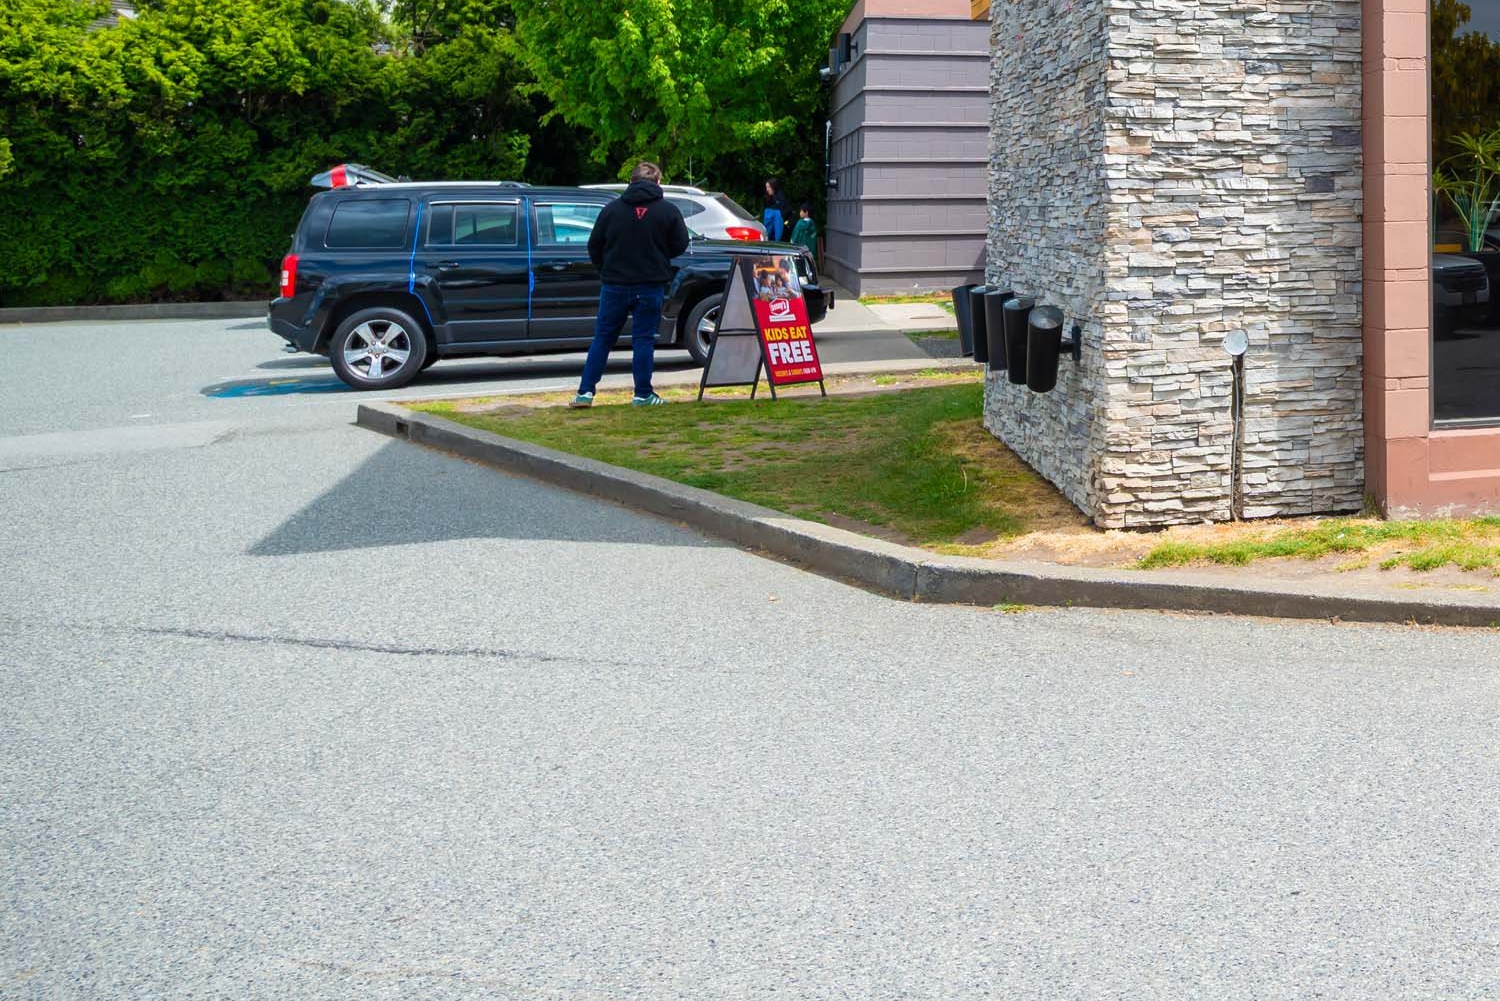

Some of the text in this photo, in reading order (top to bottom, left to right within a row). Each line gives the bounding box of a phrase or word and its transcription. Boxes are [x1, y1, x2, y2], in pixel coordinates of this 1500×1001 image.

[764, 326, 807, 341] KIDS EAT
[767, 340, 814, 365] FREE
